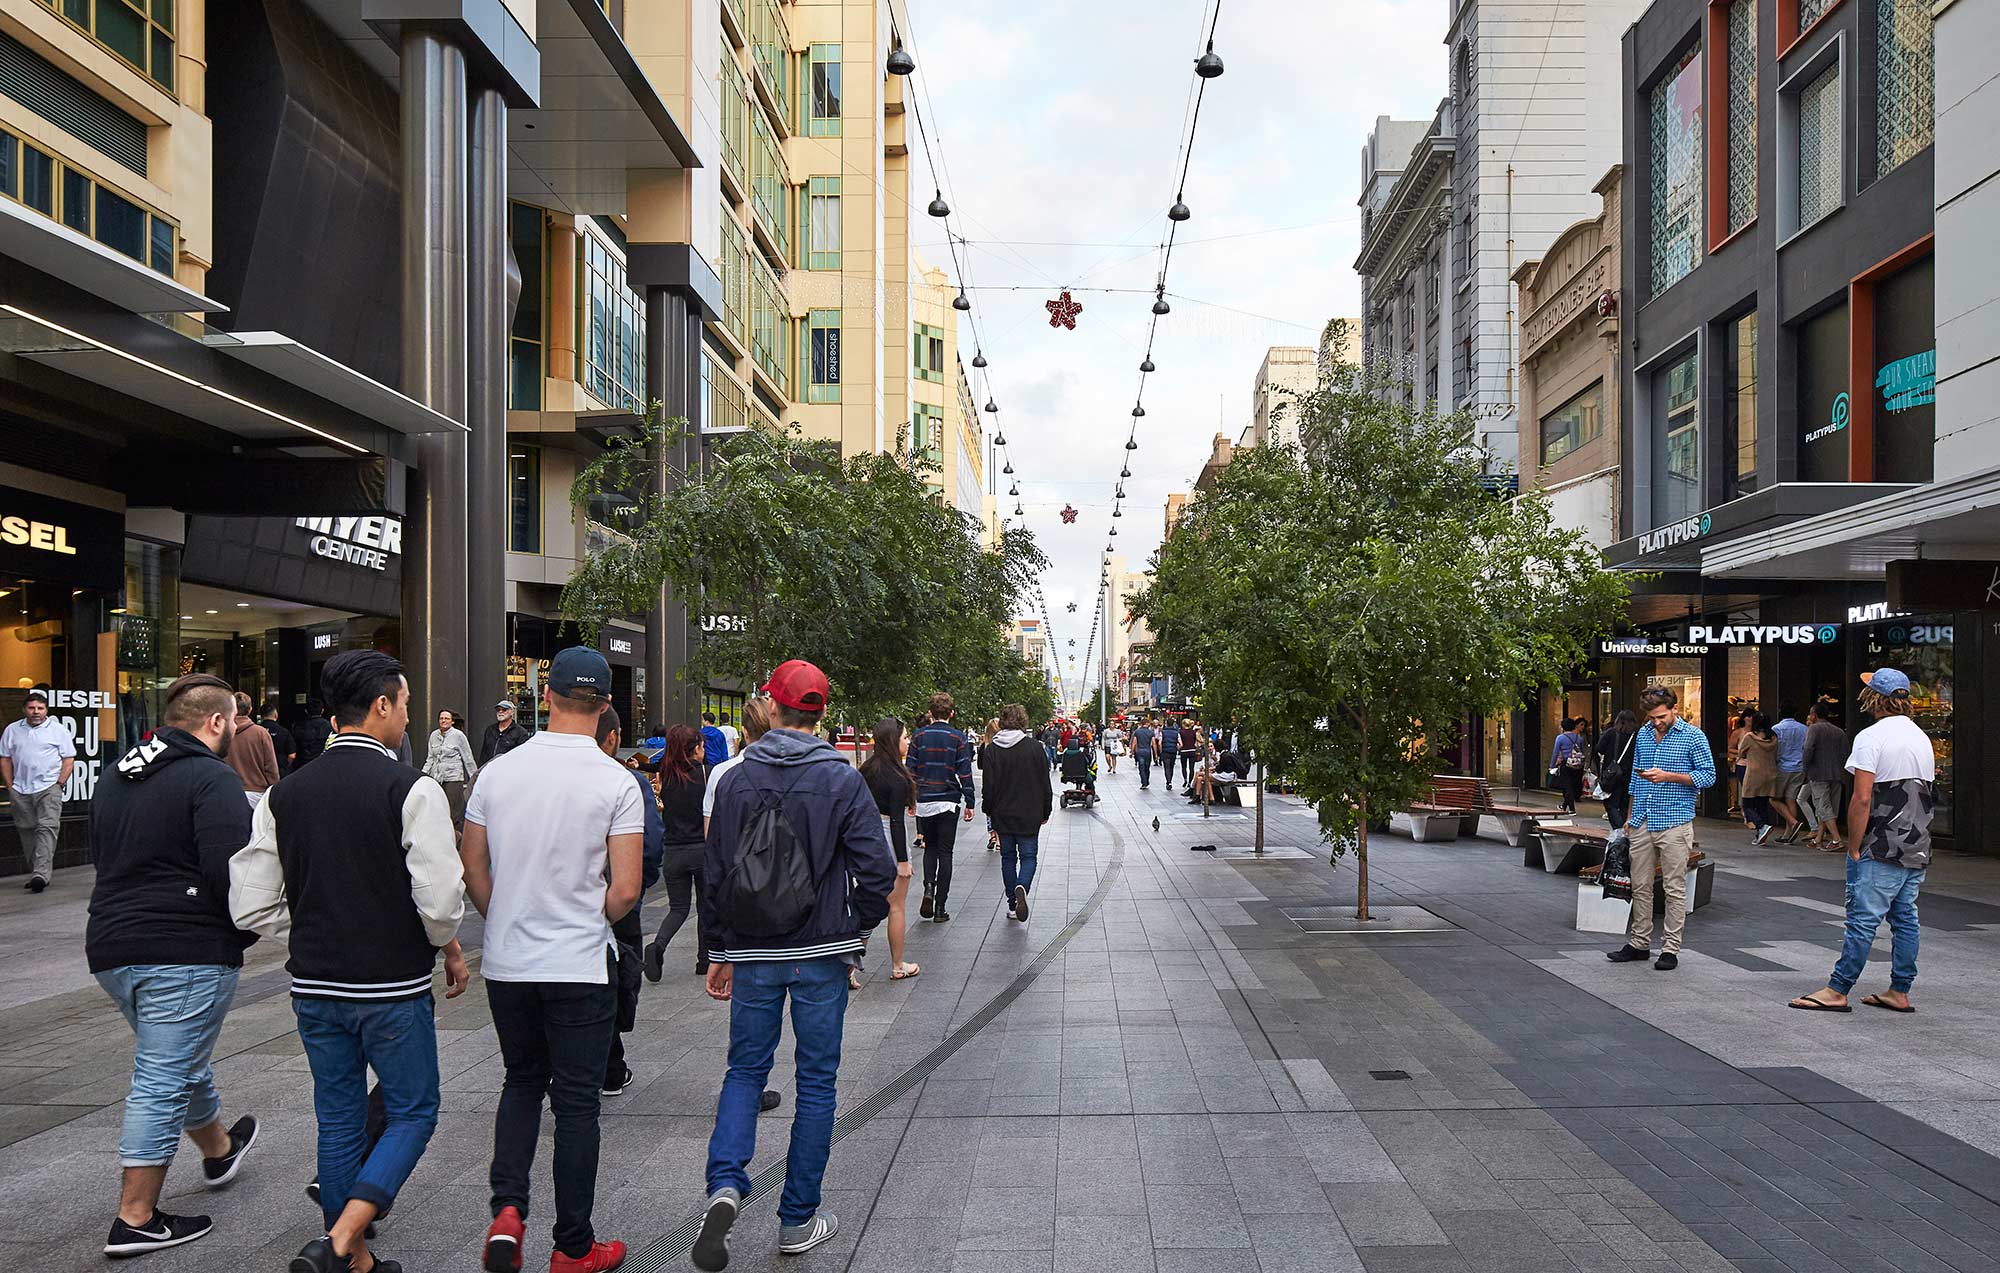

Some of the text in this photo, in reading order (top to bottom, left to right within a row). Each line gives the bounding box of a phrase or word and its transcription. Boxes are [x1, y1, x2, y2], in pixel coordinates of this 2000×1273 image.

[829, 333, 838, 380] shoeshed
[1805, 422, 1837, 443] PLATYPUS
[0, 515, 77, 555] SEL
[1638, 517, 1699, 556] PLATYPUS
[311, 535, 388, 571] CENTRE
[314, 634, 331, 649] LUSH
[1602, 641, 1709, 654] Universal Store
[1689, 625, 1815, 644] PLATYPUS
